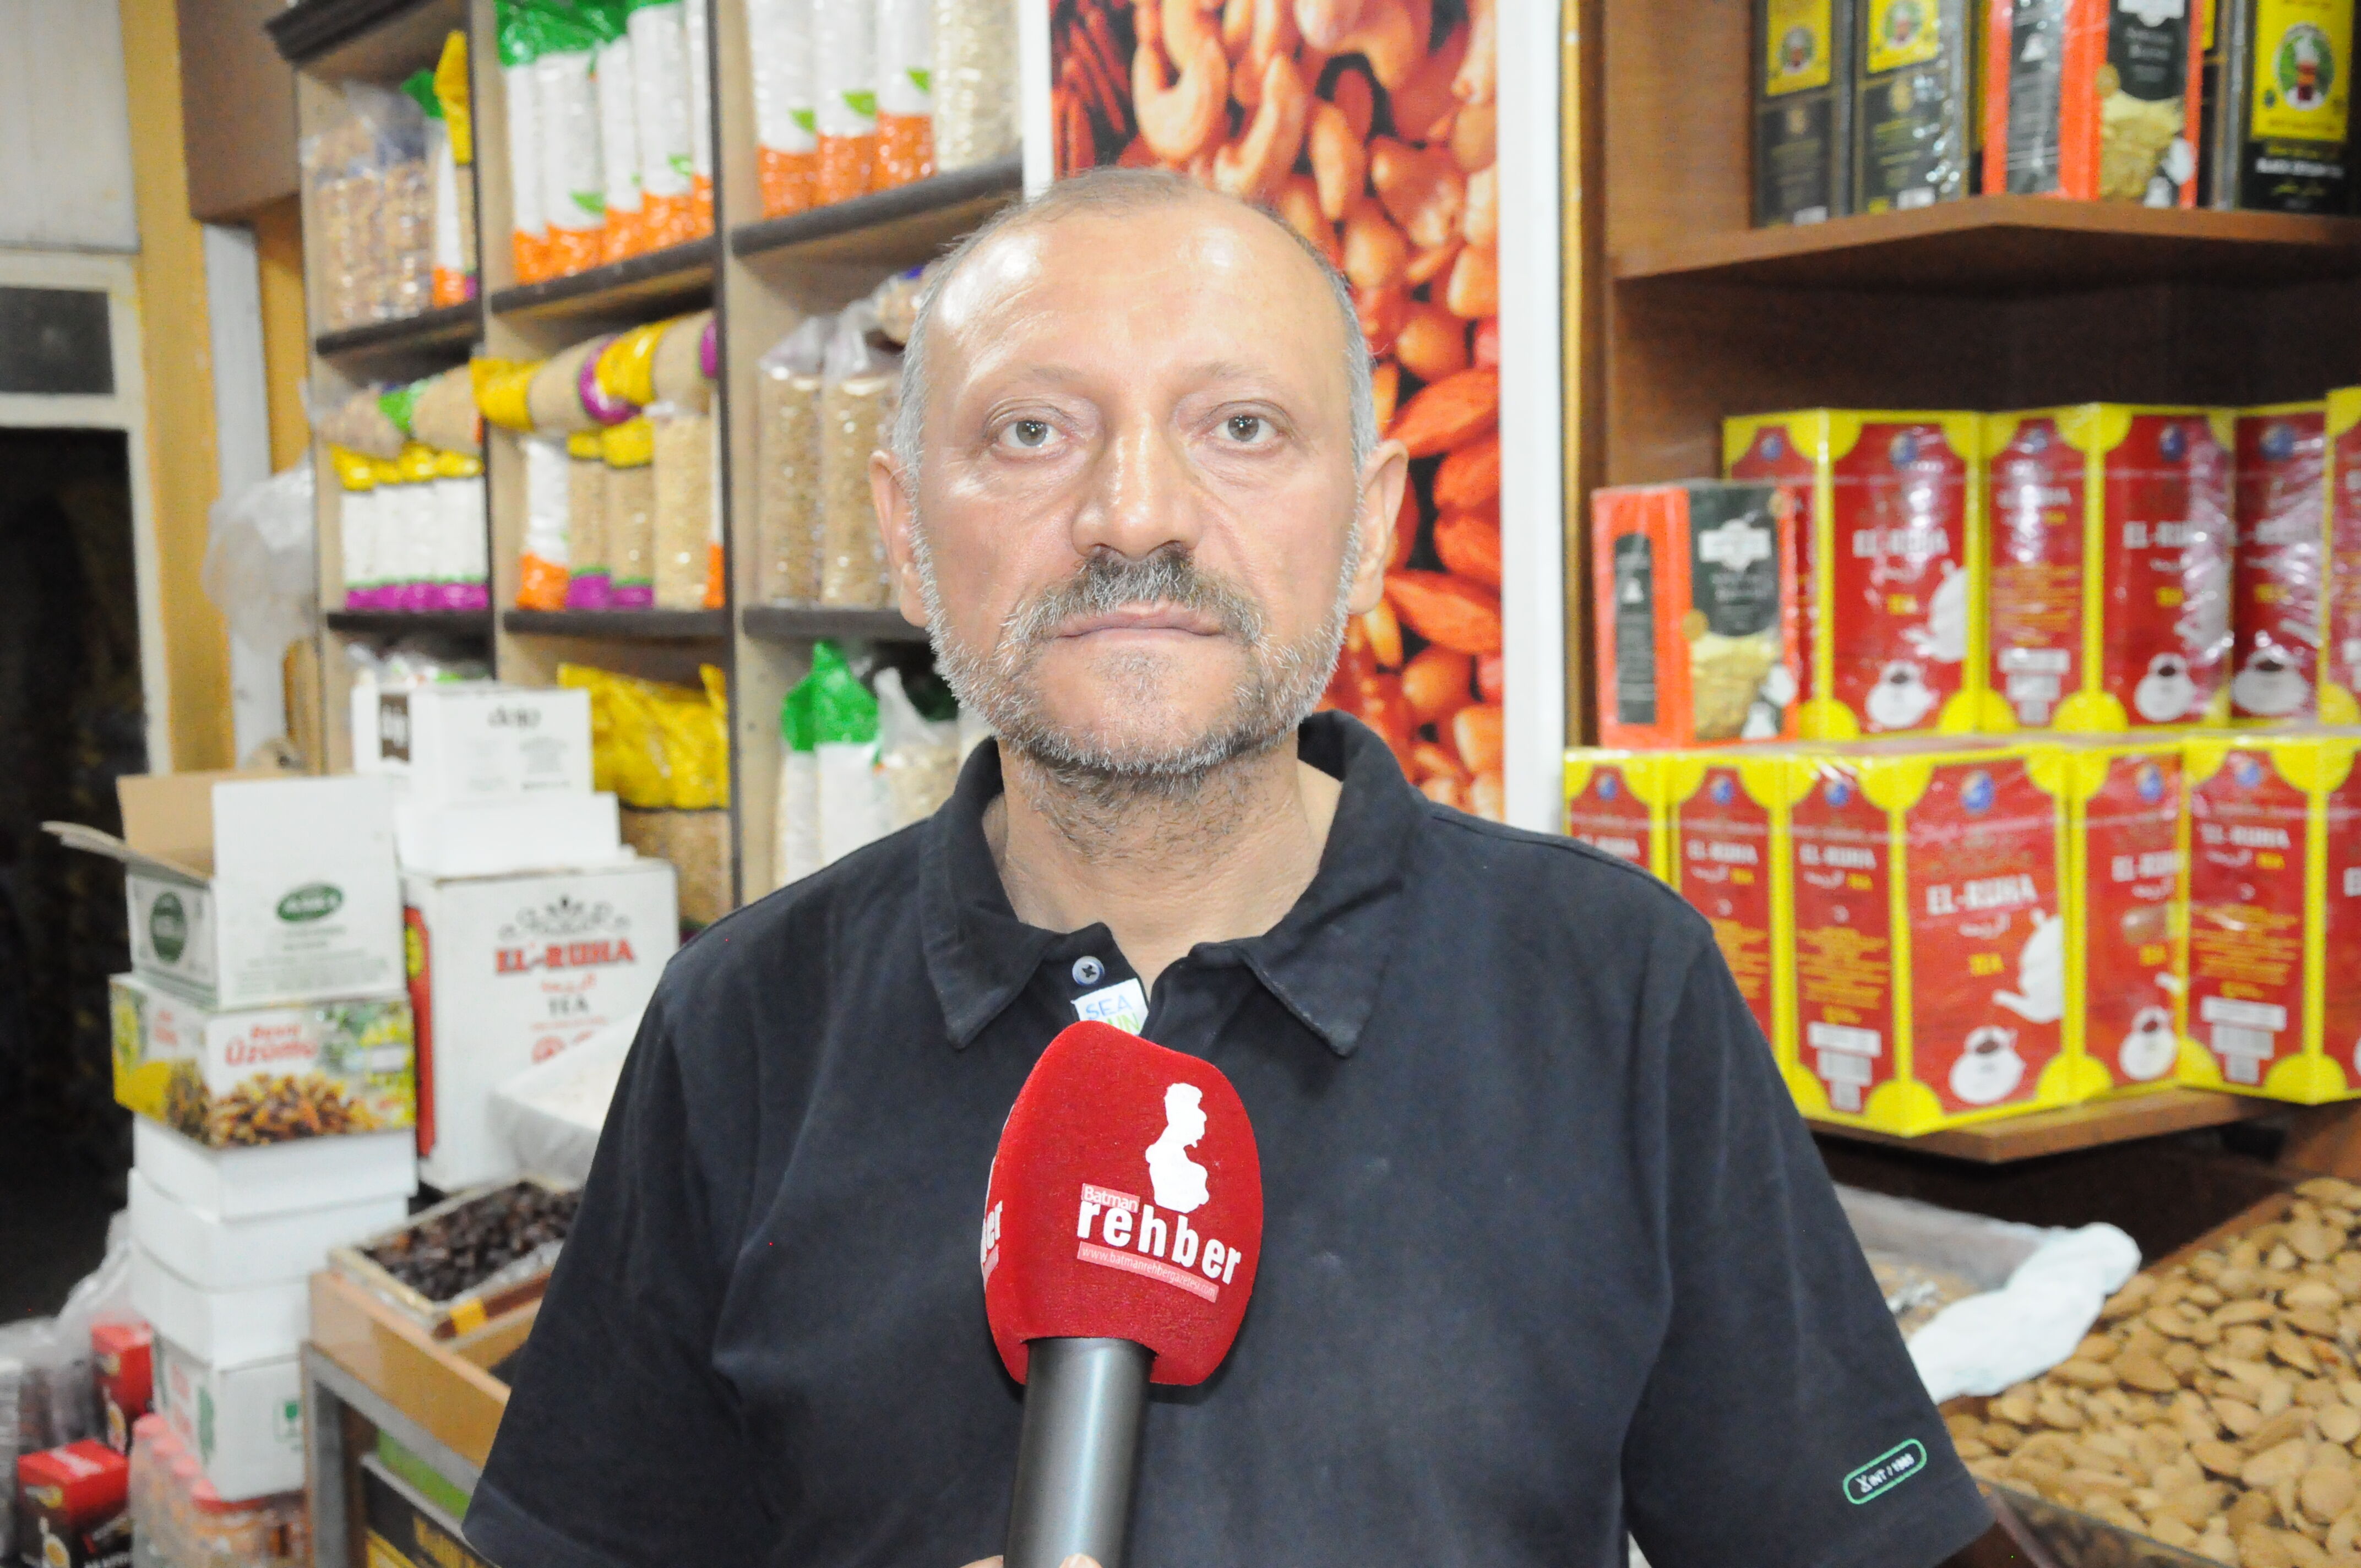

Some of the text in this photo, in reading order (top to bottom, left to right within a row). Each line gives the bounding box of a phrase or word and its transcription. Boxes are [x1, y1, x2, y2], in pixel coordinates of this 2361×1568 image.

[1926, 873, 2038, 916] EL-RUHA
[496, 938, 637, 973] EL-RUHA
[1085, 995, 1133, 1021] SEA
[1084, 1186, 1139, 1211] Batman
[1077, 1200, 1242, 1285] rehber
